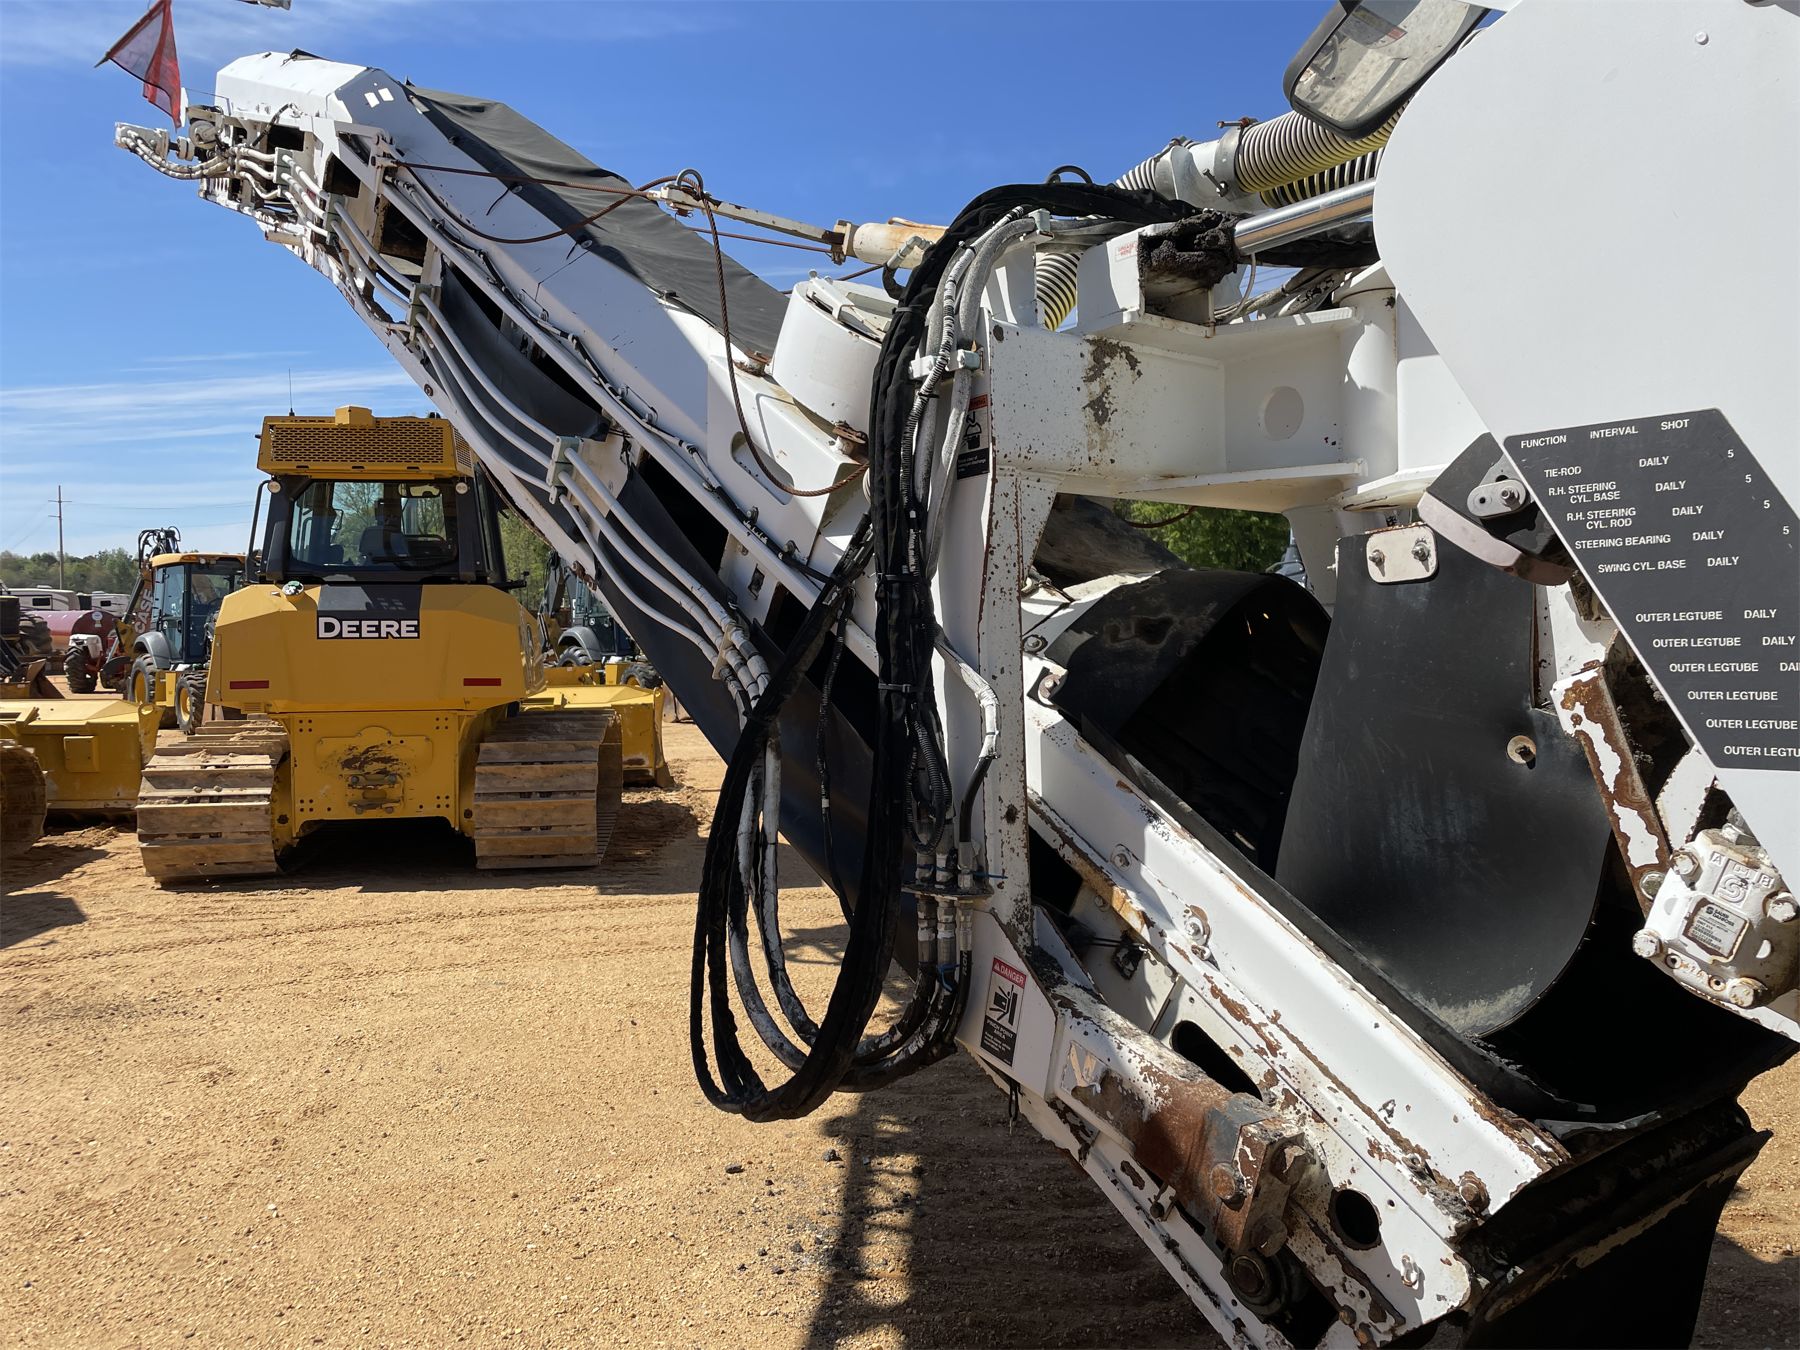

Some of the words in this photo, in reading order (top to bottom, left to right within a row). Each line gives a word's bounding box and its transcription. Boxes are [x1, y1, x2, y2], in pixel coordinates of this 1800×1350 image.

[1521, 435, 1567, 449] FUNCTION
[1590, 425, 1638, 439] INTERVAL
[1661, 419, 1689, 430] SHOT
[1544, 466, 1581, 477] TIE-ROD
[1639, 456, 1670, 467] DAILY
[1727, 448, 1735, 459] 5
[1549, 487, 1566, 496] R.H.
[1568, 481, 1616, 494] STEERING
[1656, 480, 1686, 491] DAILY
[1745, 473, 1752, 484] 5
[1570, 495, 1591, 504] CYL.
[1593, 490, 1620, 501] BASE
[1567, 512, 1585, 521] R.H.
[1587, 507, 1636, 520] STEERING
[1672, 505, 1703, 516] DAILY
[1763, 499, 1771, 509] 5
[1586, 521, 1608, 529] CYL.
[1610, 518, 1632, 527] ROD
[1575, 538, 1623, 549] STEERING
[1625, 534, 1671, 546] BEARING
[1693, 530, 1724, 541] DAILY
[1782, 525, 1790, 535] 5
[1598, 563, 1630, 573] SWING
[1633, 562, 1655, 571] CYL.
[1658, 560, 1686, 569] BASE
[1707, 556, 1739, 566] DAILY
[134, 589, 153, 633] CASE
[1636, 613, 1670, 622] OUTER
[1673, 611, 1723, 621] LEGTUBE
[1744, 609, 1776, 618] DAILY
[318, 617, 418, 638] DEERE
[1653, 639, 1688, 647] OUTER
[1691, 637, 1741, 647] LEGTUBE
[1763, 636, 1795, 645] DAILY
[1670, 664, 1705, 672] OUTER
[1708, 663, 1758, 672] LEGTUBE
[1780, 662, 1800, 671] DAI
[1688, 691, 1723, 700] OUTER
[1726, 691, 1778, 700] LEGTUBE
[1706, 719, 1742, 728] OUTER
[1746, 720, 1798, 729] LEGTUBE
[1724, 746, 1761, 755] OUTER
[1000, 965, 1025, 985] DANGER
